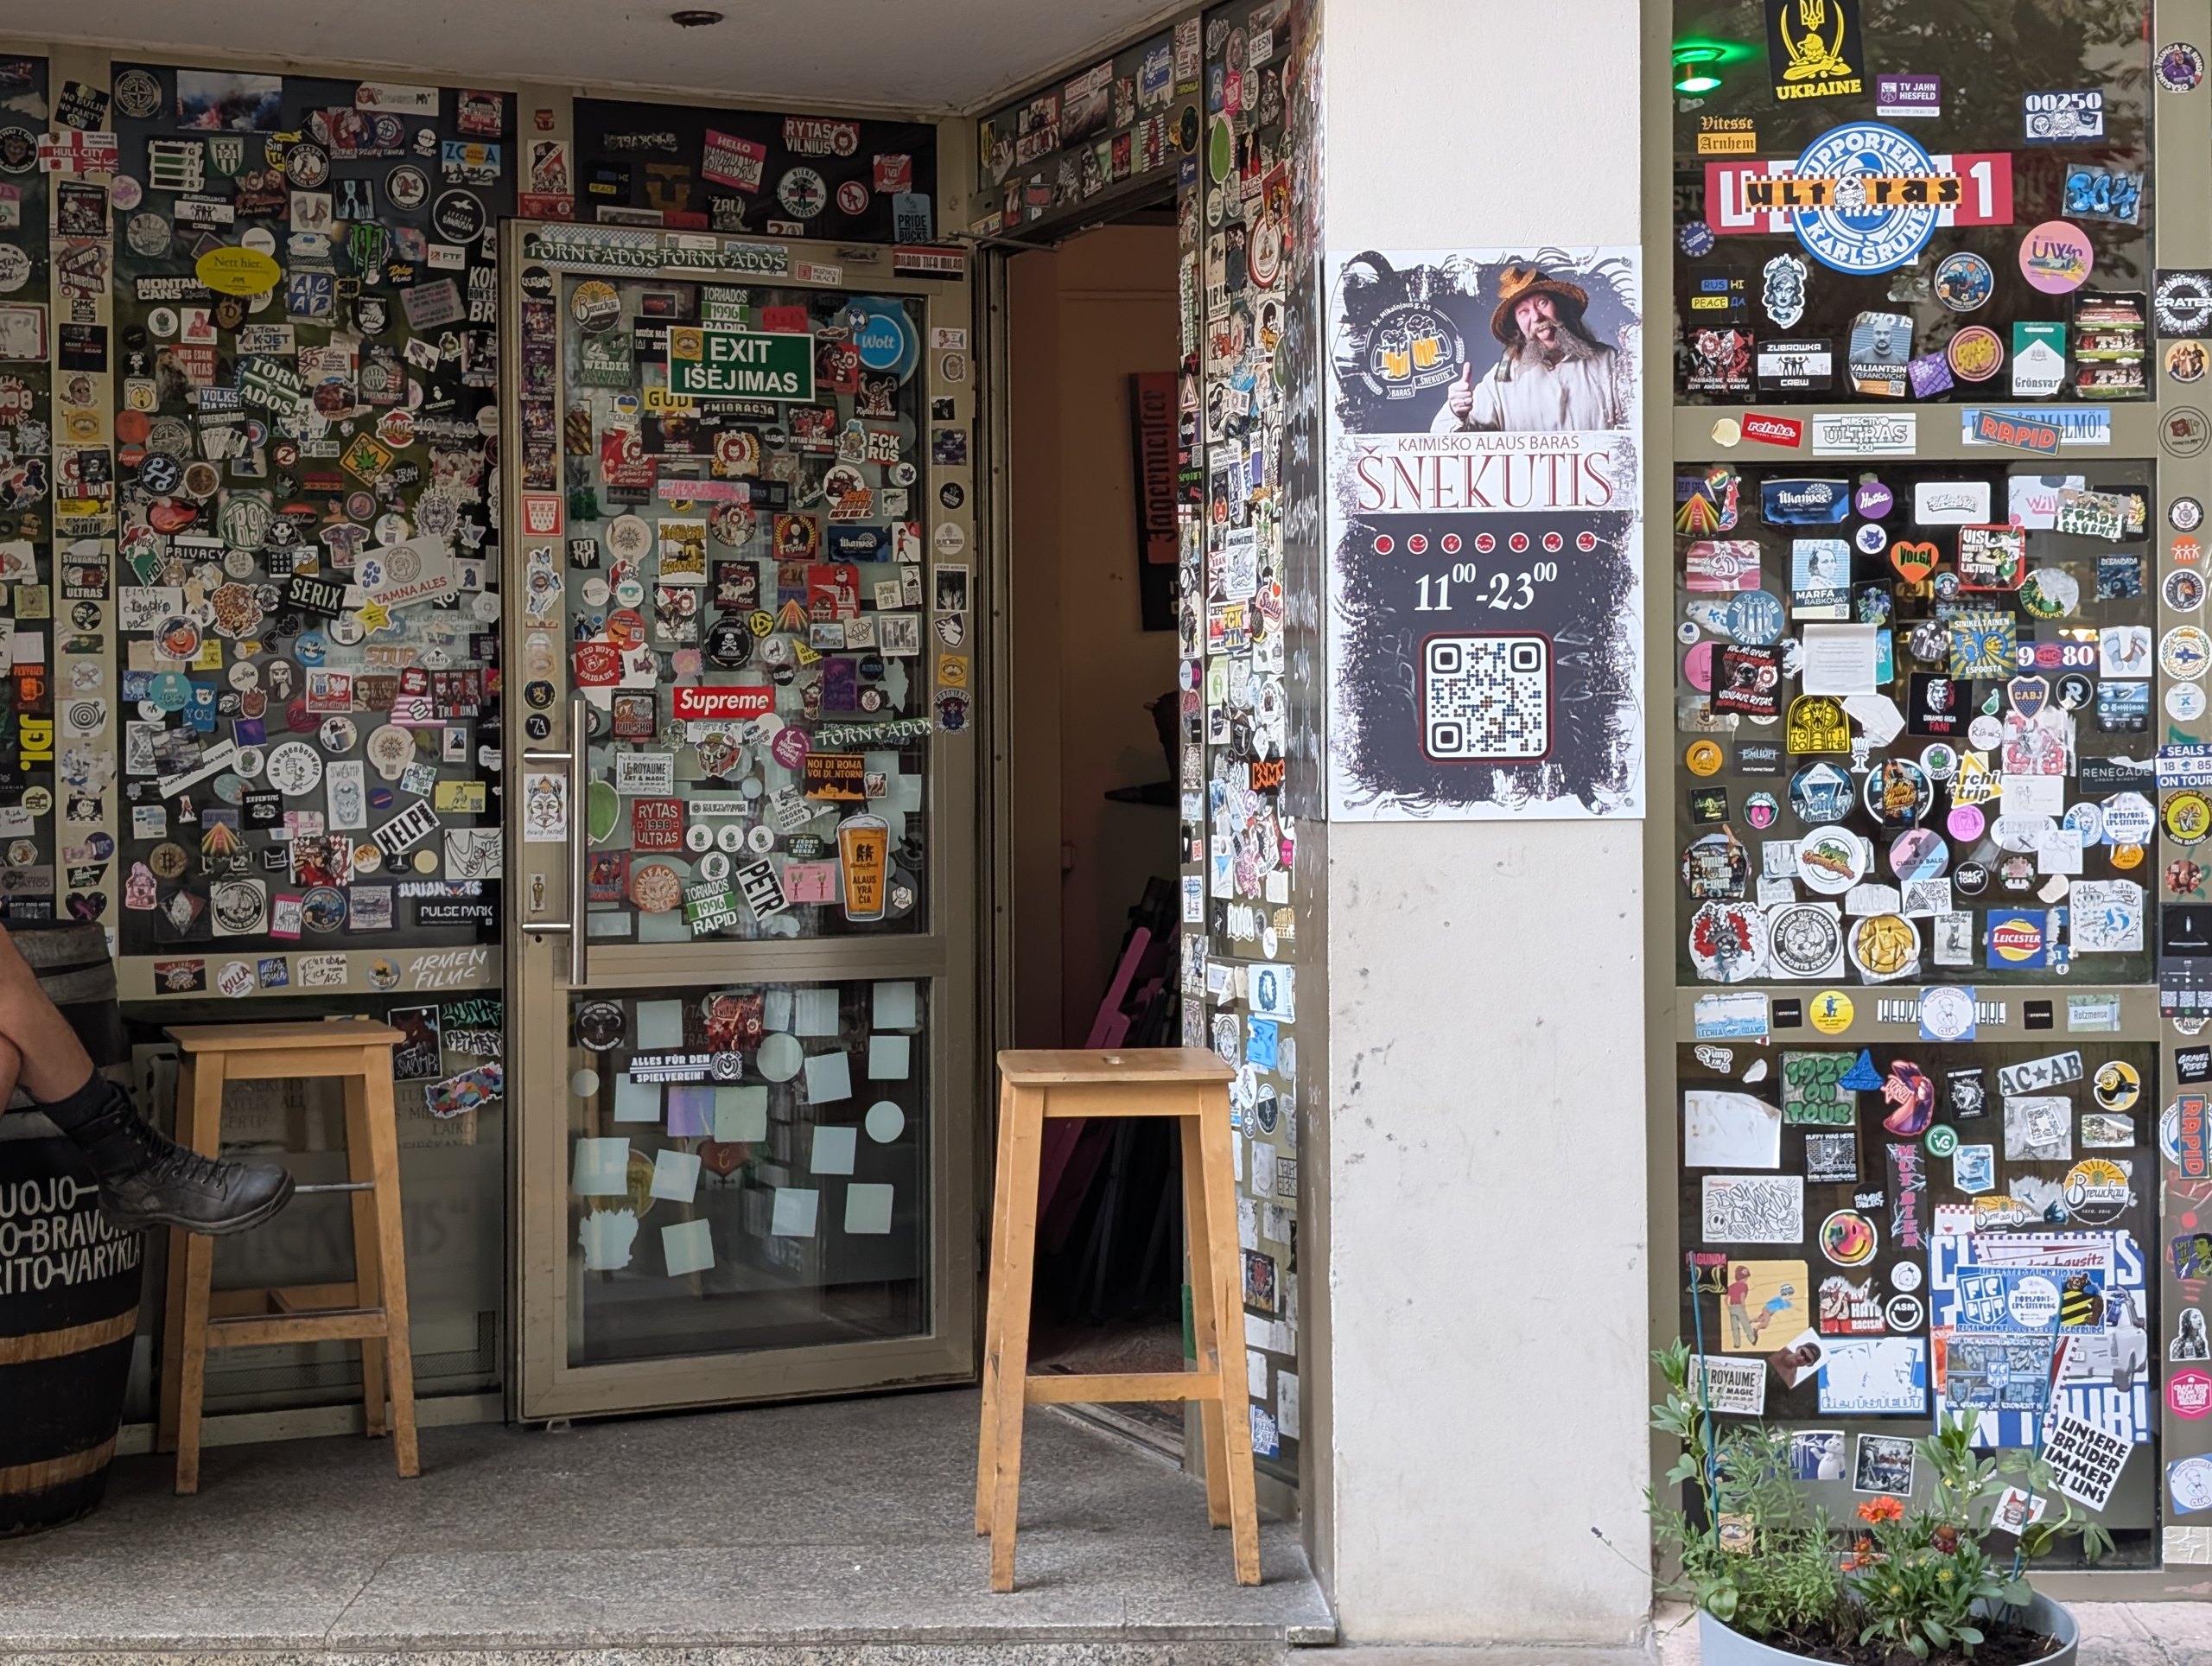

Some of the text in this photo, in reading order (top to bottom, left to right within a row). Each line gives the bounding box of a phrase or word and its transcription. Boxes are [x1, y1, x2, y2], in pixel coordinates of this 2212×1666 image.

[1257, 32, 1272, 52] ESN
[1775, 79, 1862, 100] UKRAINE
[1912, 83, 1936, 92] JAHN
[1899, 92, 1936, 101] HIESFELD
[2024, 92, 2102, 111] 00250
[785, 121, 833, 138] RYTAS
[1700, 115, 1754, 130] Vitesse
[717, 134, 752, 153] HELLO
[785, 138, 832, 156] VILNIUS
[1700, 133, 1755, 150] Arnhem
[53, 148, 105, 158] HULL CITY
[1803, 131, 1923, 175] UPPORTERS
[898, 214, 927, 228] PRIDE
[899, 229, 927, 244] BUCKS
[1803, 208, 1930, 265] KARLSRUHE
[66, 248, 99, 270] VILNIUS
[213, 256, 239, 268] Nett
[1703, 281, 1726, 289] RUS
[137, 289, 182, 301] CANS
[703, 286, 747, 303] TORNADOS
[72, 300, 96, 310] DMC
[1694, 298, 1726, 308] PEACE
[2154, 297, 2212, 308] CRATER
[862, 333, 896, 350] Wolt
[710, 337, 772, 364] EXIT
[583, 359, 630, 372] WERDER
[1851, 364, 1908, 373] VALIANTSIN
[684, 364, 798, 393] IŠĖJIMAS
[202, 390, 238, 403] VOLKS
[1391, 388, 1412, 397] BARAS
[607, 414, 639, 423] UKRAINE
[1823, 425, 1908, 443] ULTRAS
[1980, 416, 2057, 449] RAPID
[868, 433, 900, 448] FCK
[1398, 435, 1580, 451] KAIMIŠKO ALAUS BARAS
[868, 447, 899, 462] RUS
[1357, 445, 1613, 511] ŠNEKUTIS
[166, 546, 226, 561] PRIVACY
[1900, 546, 1932, 568] VOLGA
[67, 588, 104, 599] ULTRAS
[289, 578, 342, 611] SERIX
[373, 575, 448, 605] TAMNA ALES
[1796, 588, 1835, 601] MARFA
[1803, 596, 1848, 607] RABKOVA?
[1732, 627, 1763, 645] VIKING
[579, 668, 615, 683] BRIGADE
[680, 688, 769, 716] Supreme
[2014, 691, 2043, 700] CABJ
[1929, 722, 1950, 733] FANI
[2166, 747, 2205, 756] SEALS
[632, 763, 667, 775] ROYAUME
[807, 760, 823, 769] NOI
[836, 760, 862, 770] ROMA
[2082, 767, 2152, 778] RENEGADE
[2163, 761, 2212, 771] 18 85
[807, 769, 822, 778] VOI
[1948, 771, 1999, 785] Archi
[2159, 775, 2212, 787] ON TOUR
[1957, 785, 1991, 802] trip
[638, 804, 678, 820] RYTAS
[779, 809, 804, 823] GEGEN
[645, 819, 671, 830] 1998
[782, 815, 806, 828] RECHTE
[376, 809, 428, 853] HELP
[638, 831, 679, 847] ULTRAS
[1895, 857, 1944, 867] CURLY BALD
[853, 874, 877, 885] ALAUS
[685, 879, 729, 902] TORNADOS
[856, 886, 873, 895] YRA
[858, 894, 872, 905] ČIA
[421, 906, 493, 918] PULSE PARK
[692, 911, 738, 936] RAPID
[1776, 912, 1797, 942] VILNIUS
[1993, 932, 2041, 944] LEICESTER
[1778, 950, 1834, 970] SPORTS CREW
[222, 967, 251, 992] KILLA
[1697, 1028, 1724, 1038] LECHIA
[632, 1053, 710, 1067] ALLES FÜR DEN
[2177, 1052, 2210, 1065] GRAVEL
[2181, 1061, 2209, 1072] RIDES
[636, 1071, 705, 1084] SPIELVEREIN!
[1802, 1081, 1838, 1103] ON
[1784, 1101, 1853, 1125] TOUR
[2182, 1099, 2206, 1176] RAPID
[1898, 1303, 1921, 1312] ASM
[1715, 1370, 1760, 1387] ROYAUME
[2061, 1416, 2129, 1459] UNSERE
[2051, 1433, 2122, 1473] BRÜDER
[2044, 1448, 2113, 1489] IMMER
[2070, 1472, 2107, 1504] UNS
